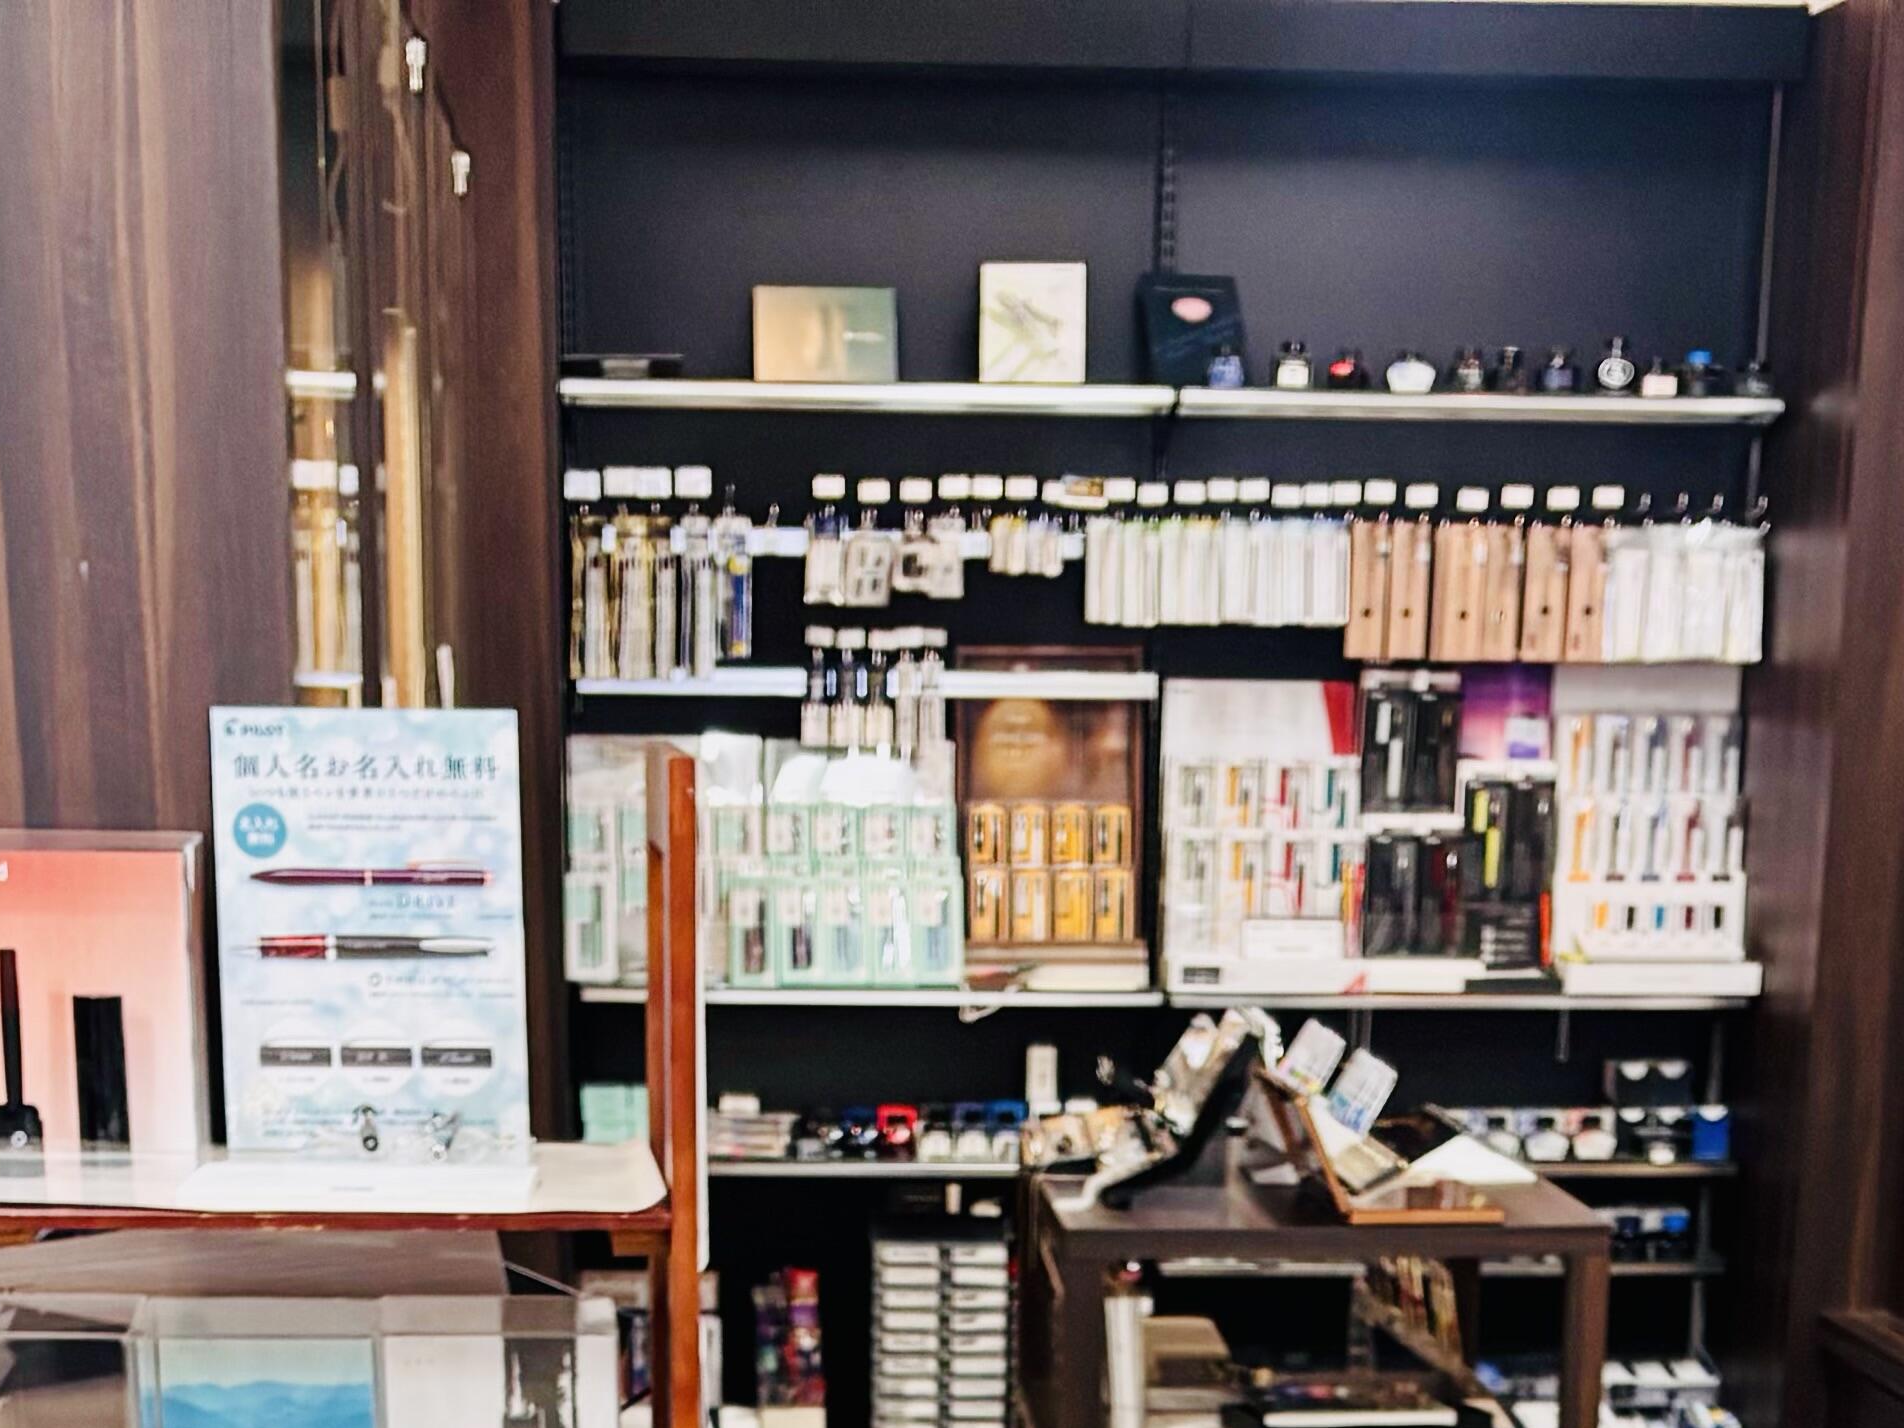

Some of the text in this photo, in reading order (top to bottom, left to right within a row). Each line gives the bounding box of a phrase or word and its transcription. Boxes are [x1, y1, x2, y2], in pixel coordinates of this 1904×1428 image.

[234, 752, 499, 781] 個人名お名入れ無料
